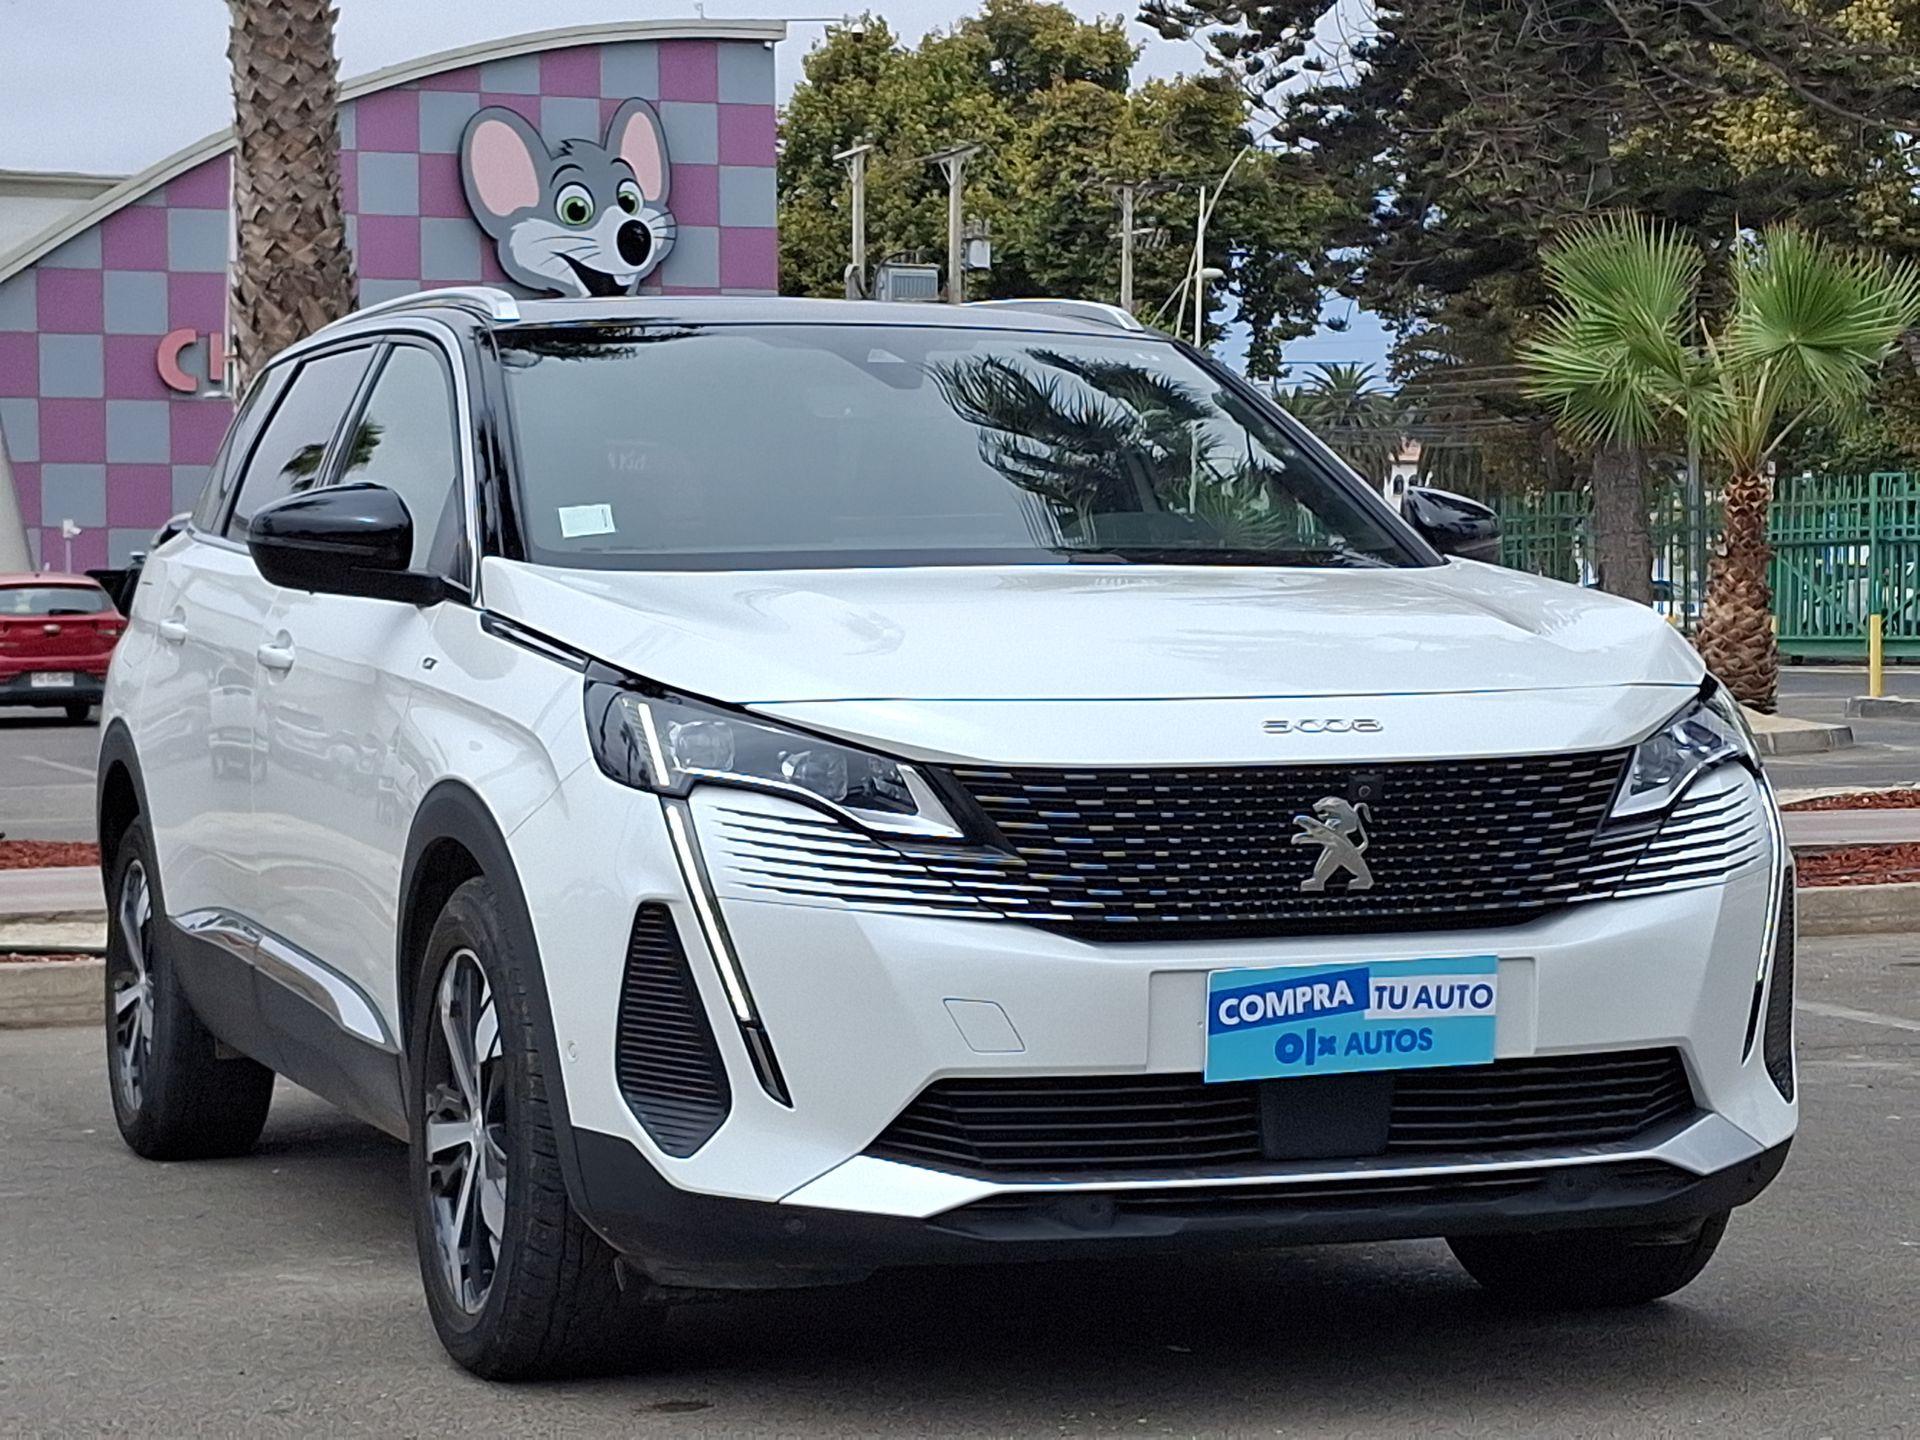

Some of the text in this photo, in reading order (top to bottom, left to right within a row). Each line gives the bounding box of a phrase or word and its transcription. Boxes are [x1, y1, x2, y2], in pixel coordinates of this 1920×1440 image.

[1217, 979, 1494, 1026] COMPRA TU AUTO
[1344, 1027, 1433, 1057] AUTOS
